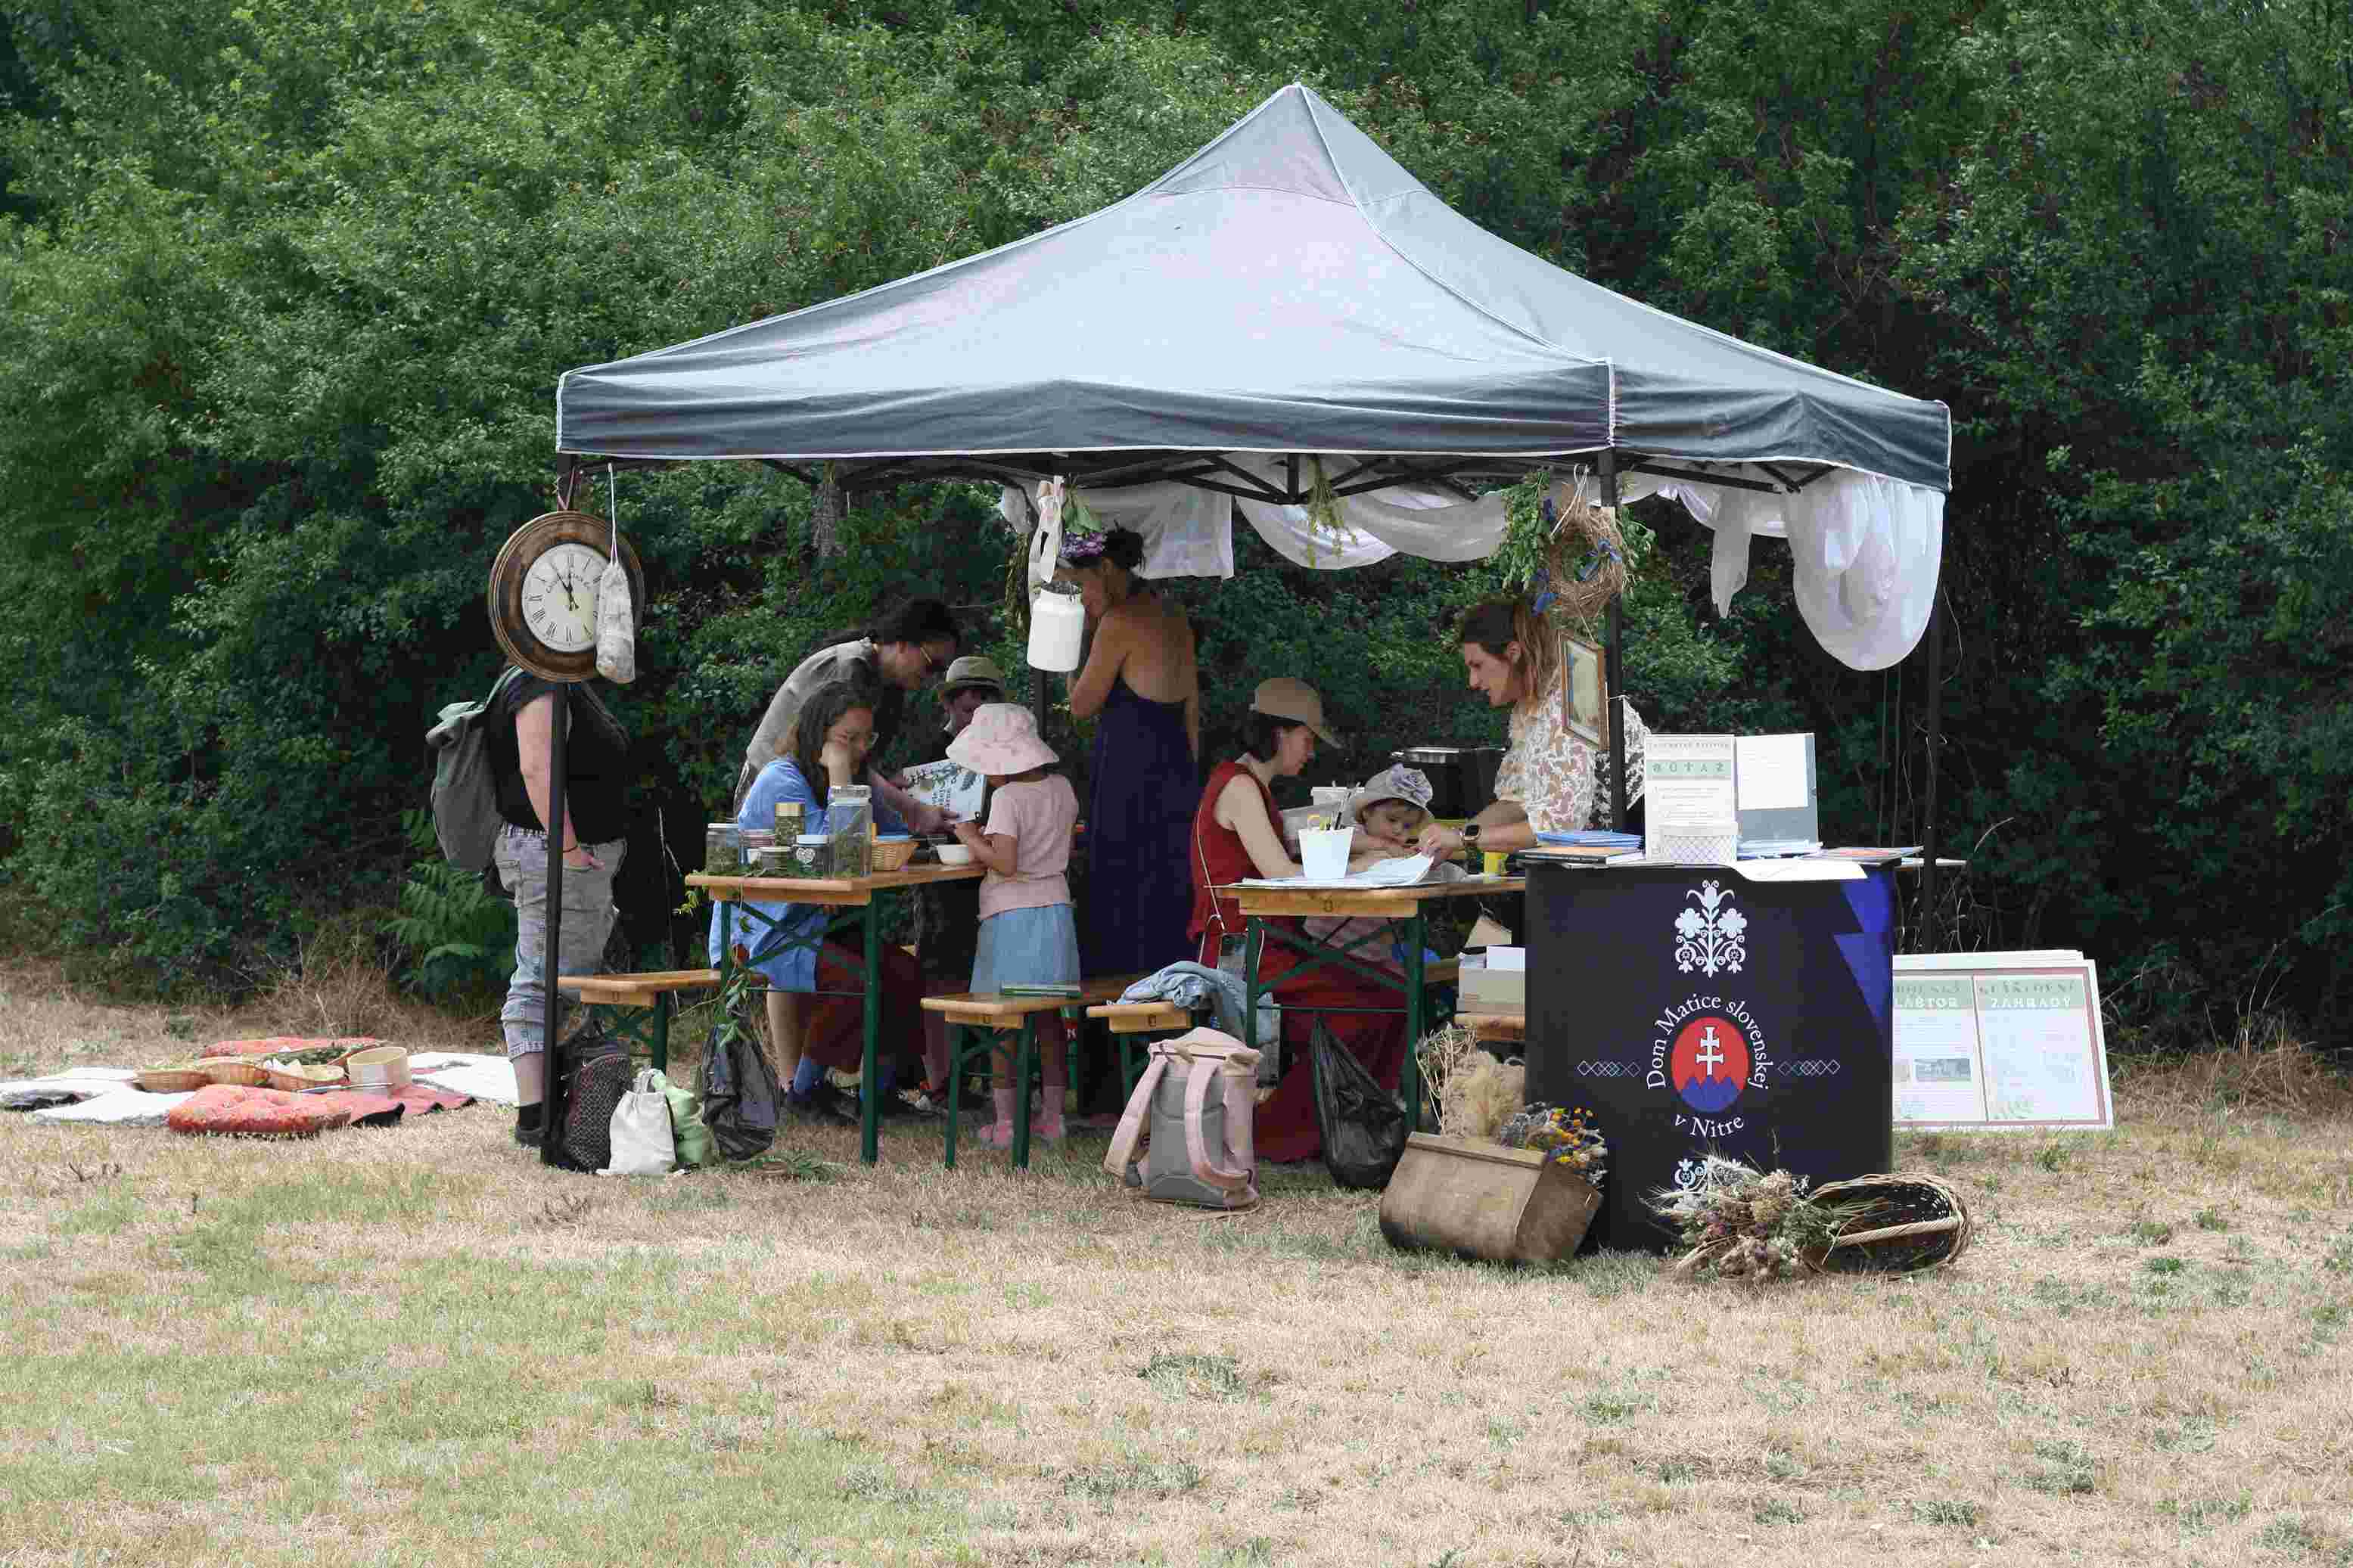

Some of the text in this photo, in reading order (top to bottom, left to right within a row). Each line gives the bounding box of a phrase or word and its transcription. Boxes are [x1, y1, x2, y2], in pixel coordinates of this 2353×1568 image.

[1646, 993, 1774, 1090] Dom Matice slovenskej
[1674, 1113, 1744, 1138] v Nitre
